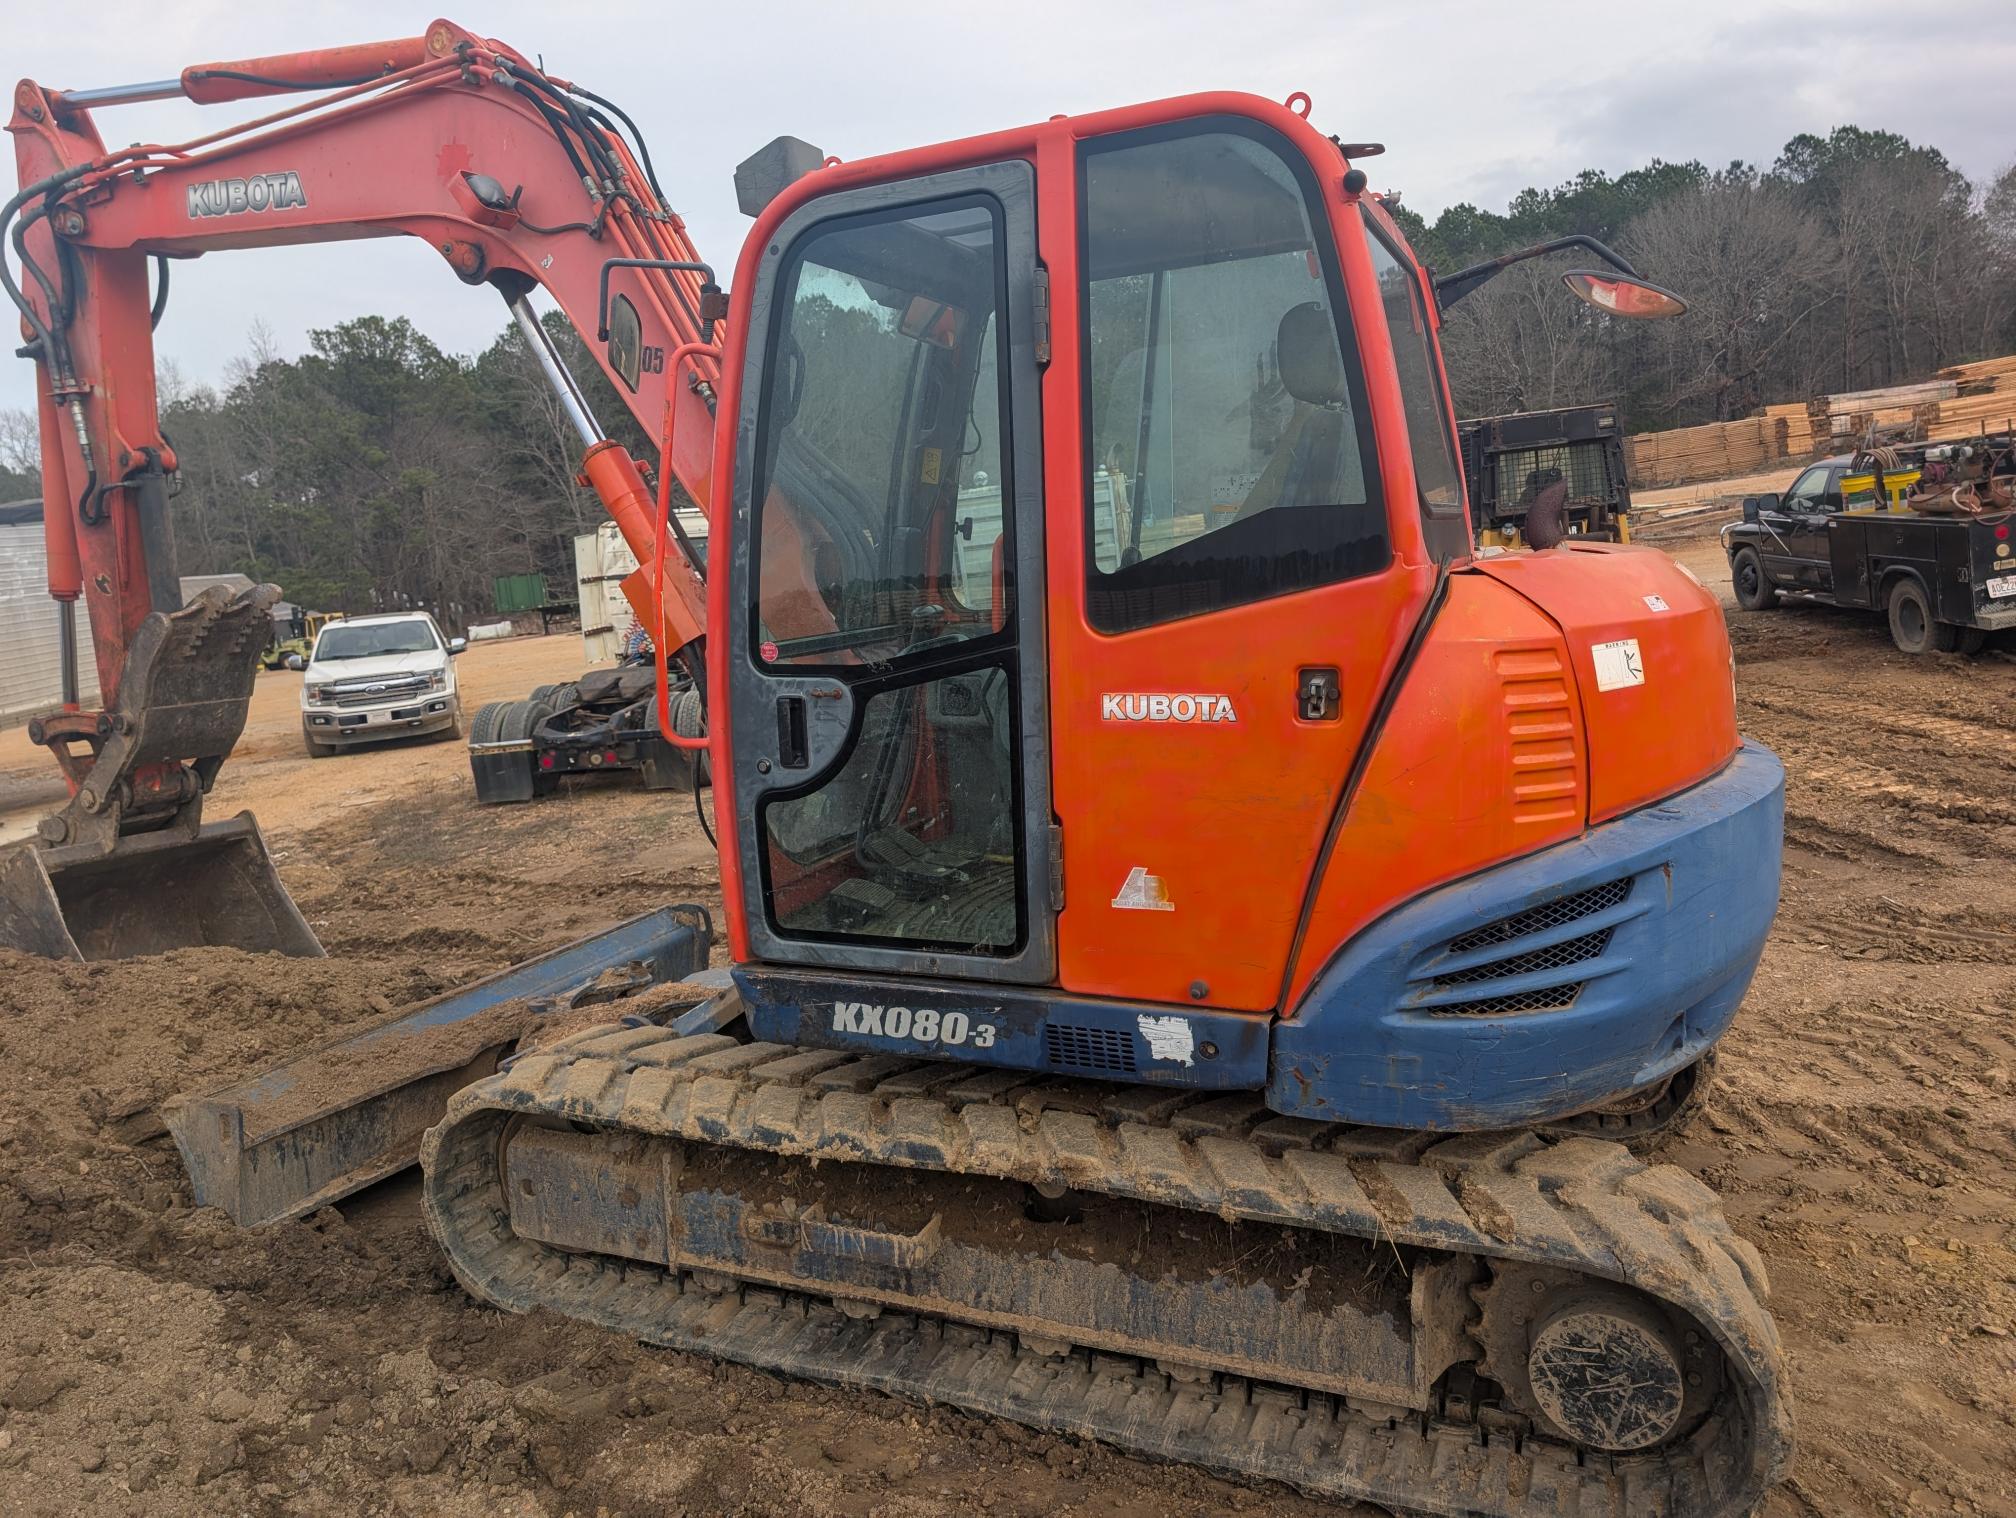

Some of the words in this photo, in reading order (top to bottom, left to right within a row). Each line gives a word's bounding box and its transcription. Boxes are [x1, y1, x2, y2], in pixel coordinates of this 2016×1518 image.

[187, 171, 307, 218] KUBOTA
[1101, 693, 1238, 723] KUBOTA
[832, 1000, 996, 1048] KX080-3
